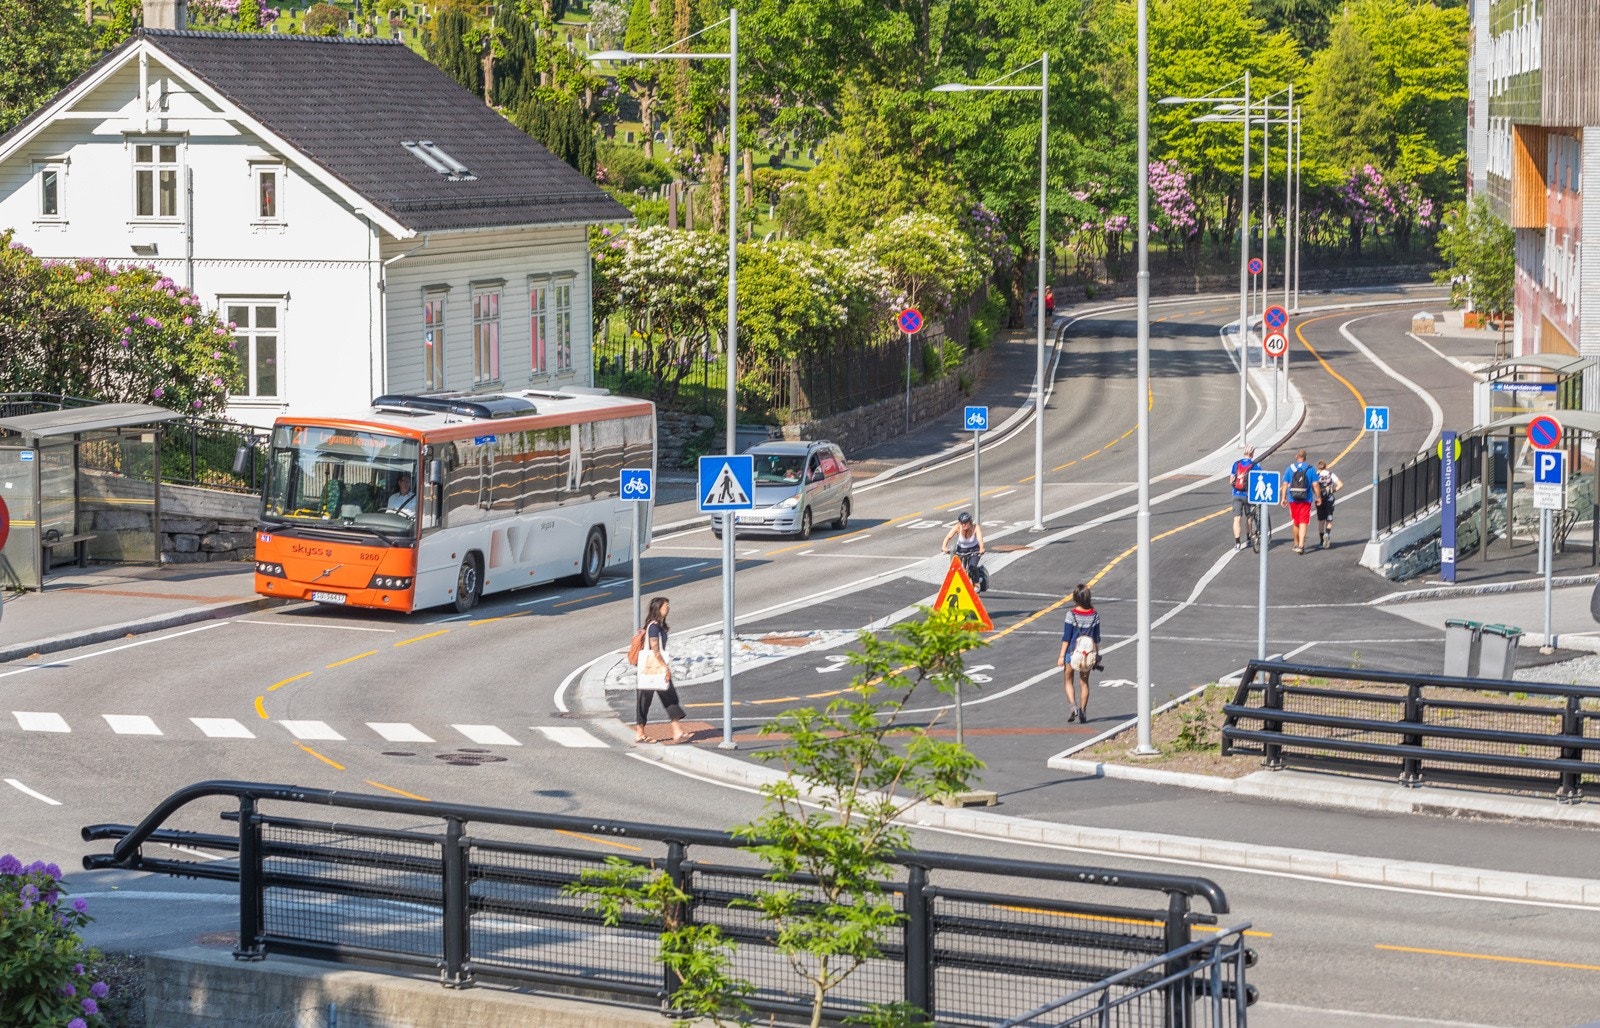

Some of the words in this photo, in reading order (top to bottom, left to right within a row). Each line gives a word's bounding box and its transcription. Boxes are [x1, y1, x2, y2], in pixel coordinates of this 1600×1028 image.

[1268, 338, 1284, 350] 40
[292, 425, 308, 446] 21
[319, 431, 353, 446] Lagunen
[1540, 454, 1556, 480] P
[292, 543, 324, 557] skyss
[359, 552, 380, 561] 8260
